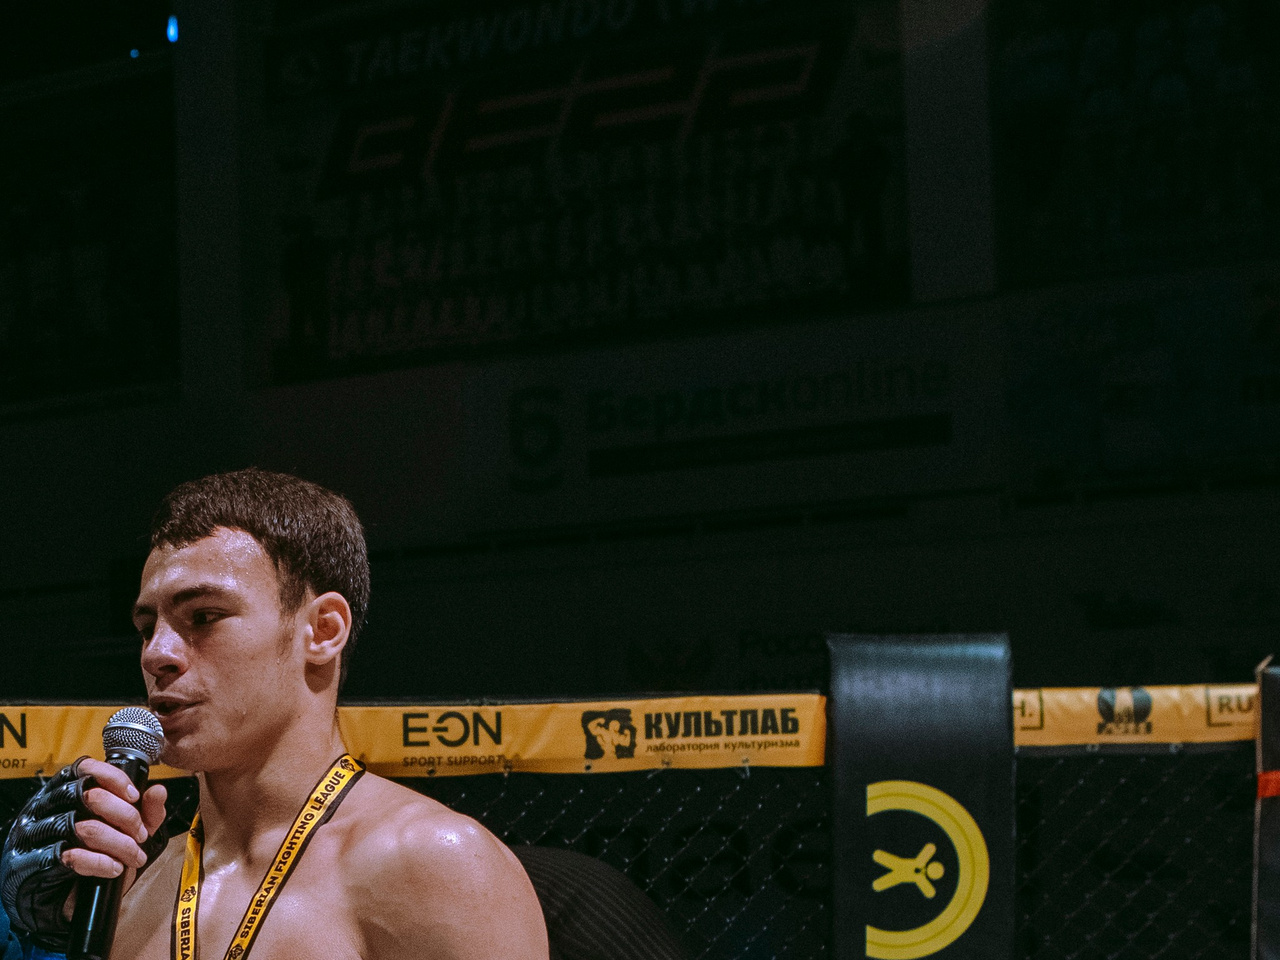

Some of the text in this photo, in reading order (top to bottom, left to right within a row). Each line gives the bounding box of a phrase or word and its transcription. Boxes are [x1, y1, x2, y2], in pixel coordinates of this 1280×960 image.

[644, 707, 800, 740] КУЛЬТЛАБ
[644, 738, 801, 754] лаборатория культуризма
[402, 754, 504, 768] SPORT SUPPORT
[240, 771, 346, 940] SIBERIAN FIGHTING LEAGUE
